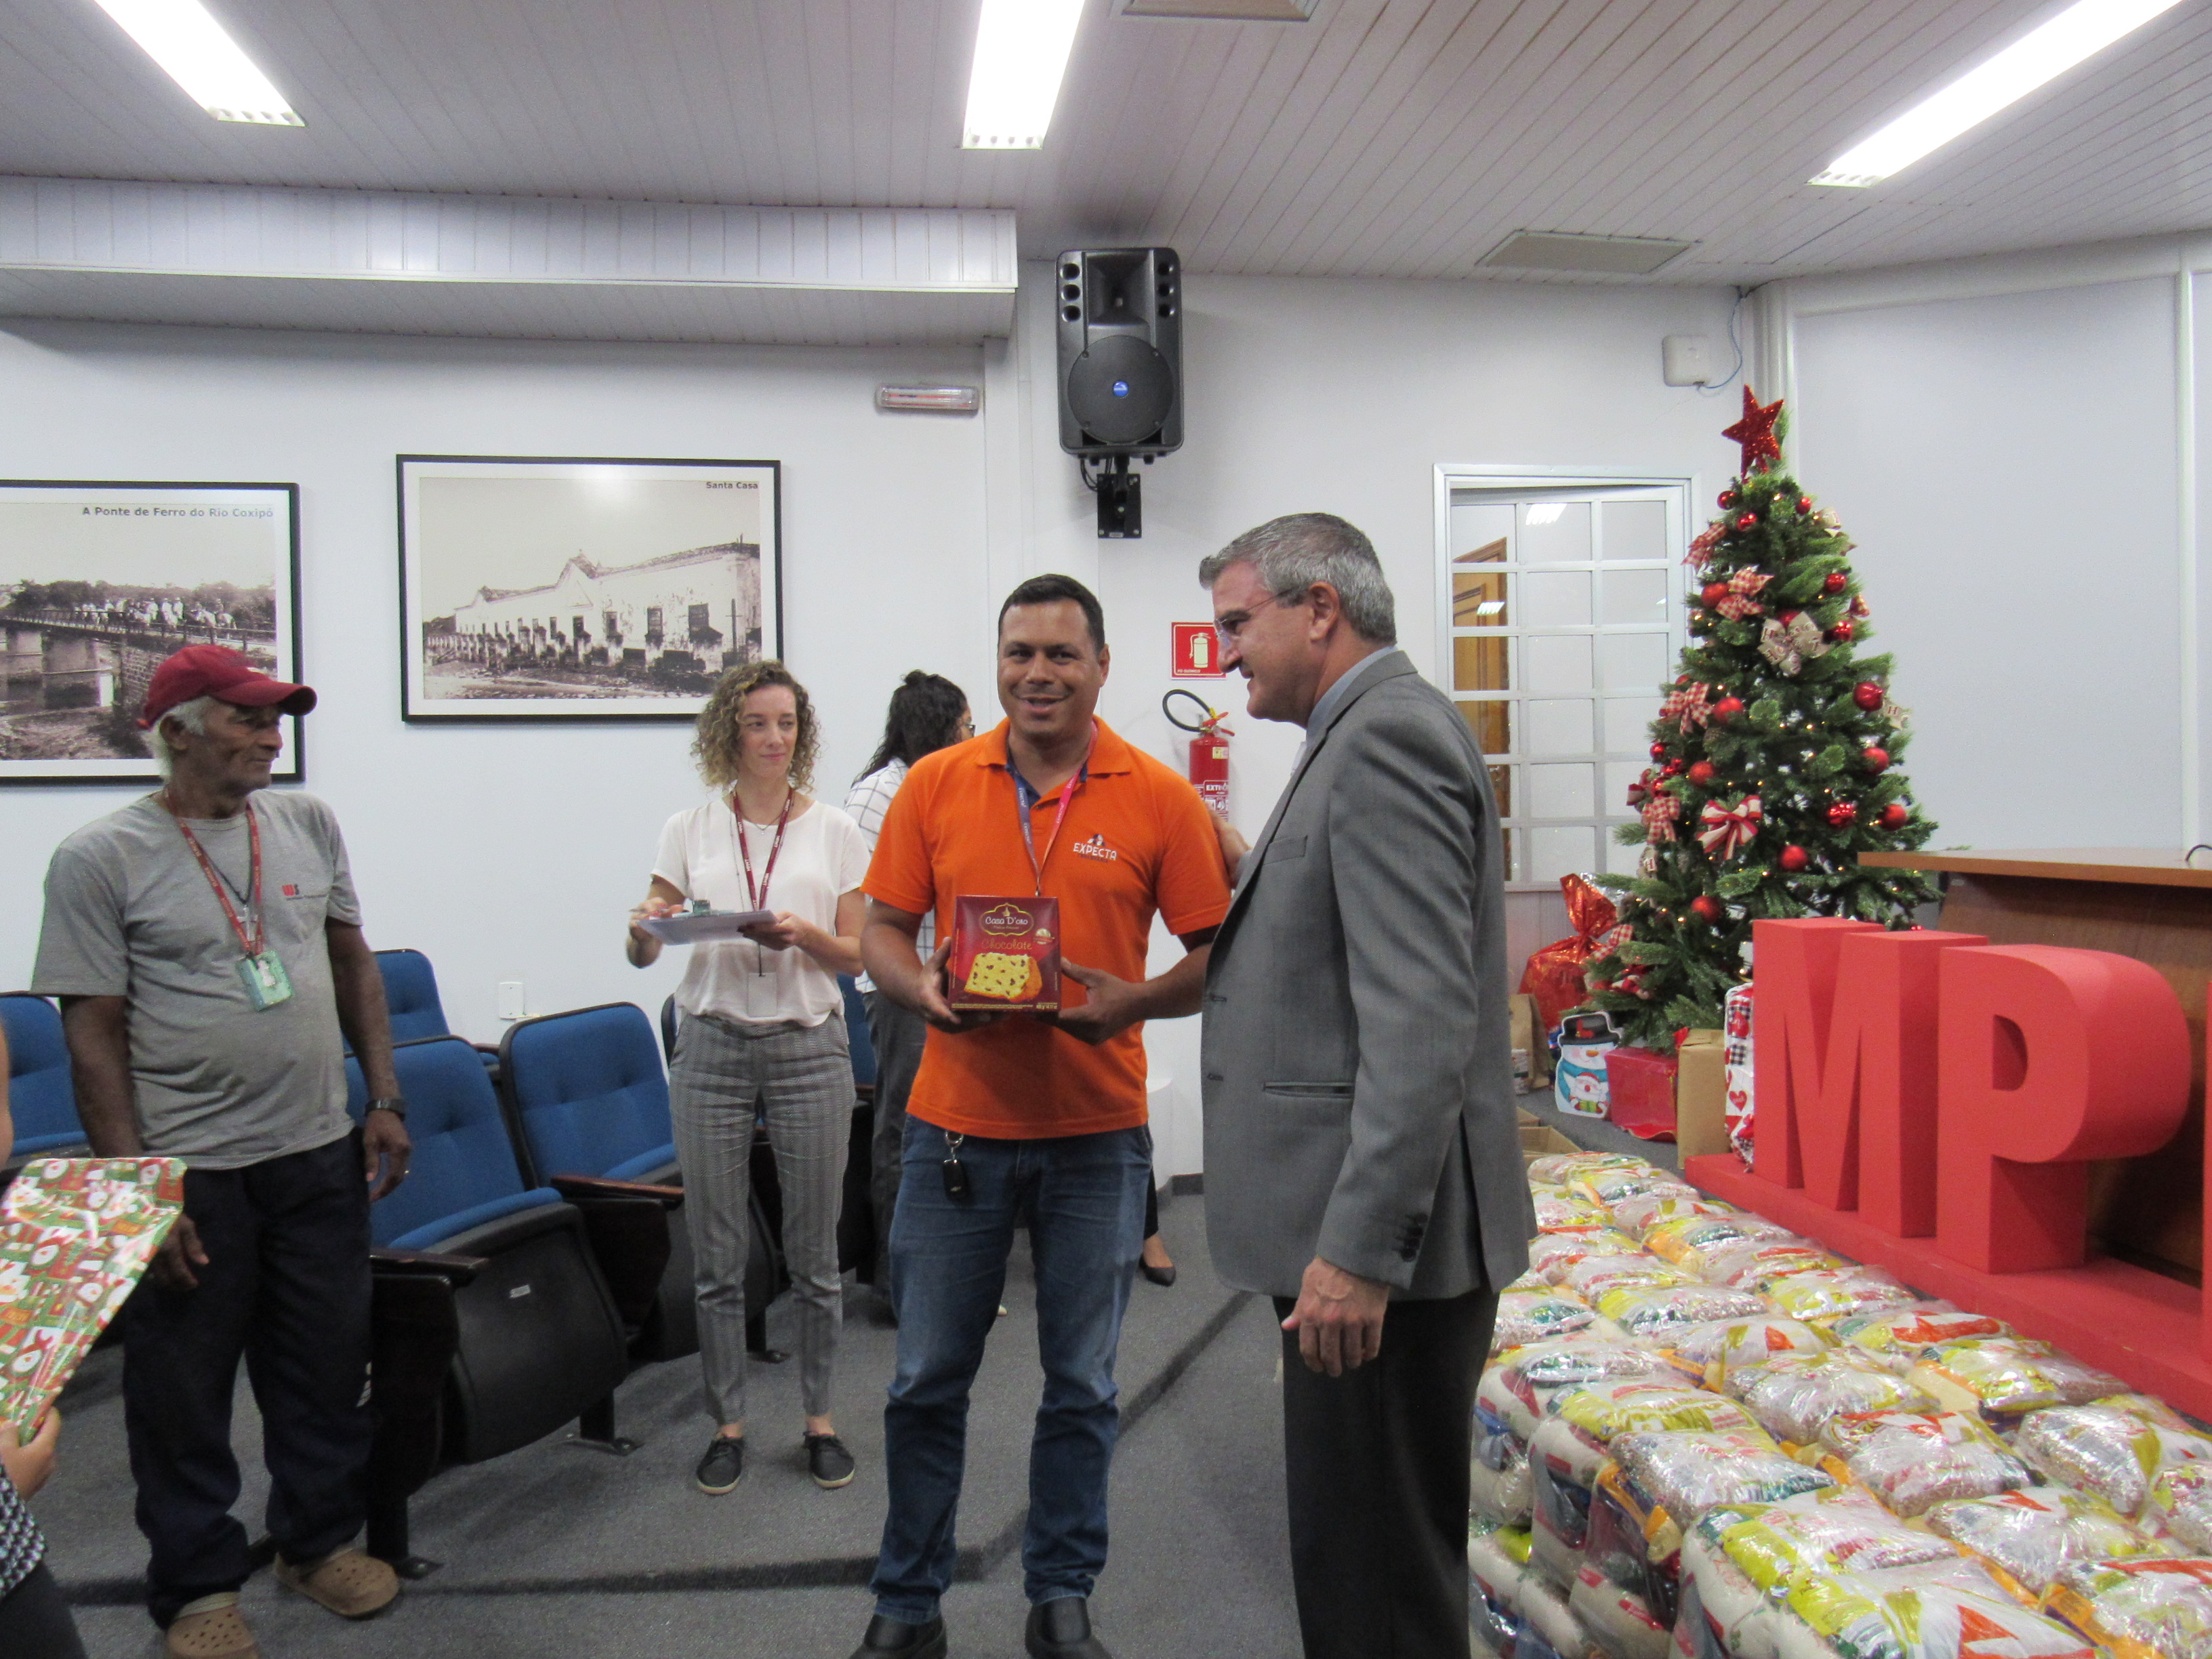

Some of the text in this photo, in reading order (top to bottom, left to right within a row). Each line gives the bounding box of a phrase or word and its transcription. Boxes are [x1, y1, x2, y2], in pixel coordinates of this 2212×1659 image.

[82, 507, 273, 518] A Ponte de Ferro do Rio Coxipó
[1073, 842, 1118, 861] EXPECTA
[985, 916, 1004, 924] Casa
[983, 938, 1032, 950] Chocolate
[1753, 916, 2212, 1355] MP
